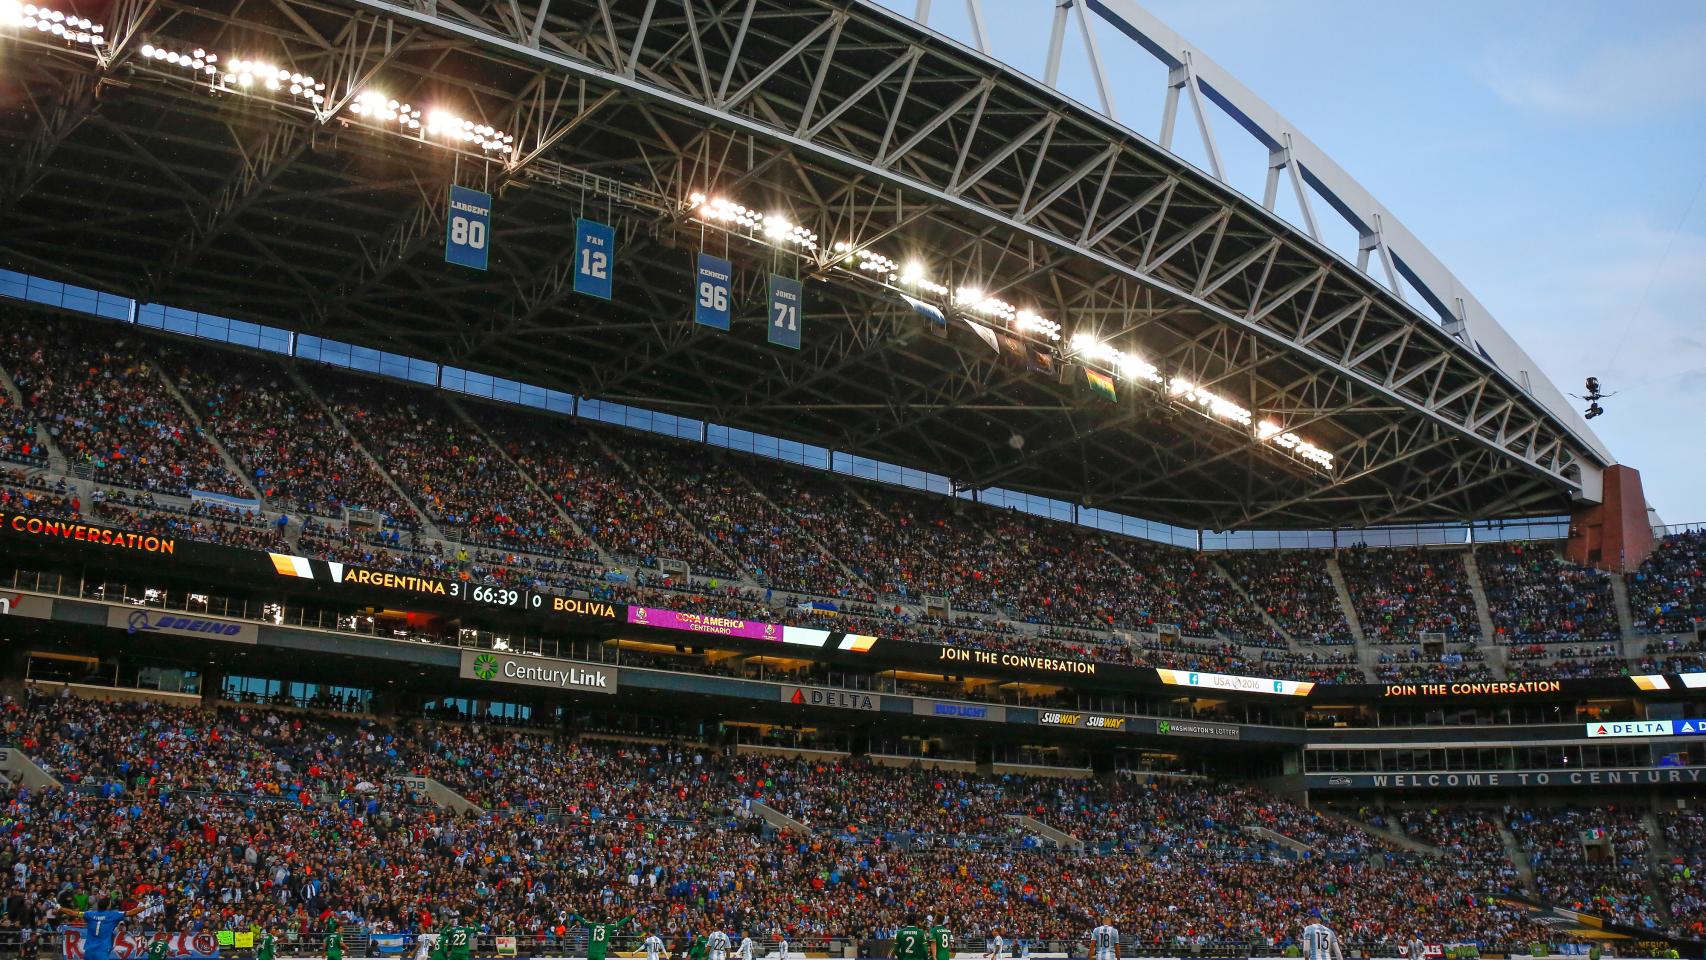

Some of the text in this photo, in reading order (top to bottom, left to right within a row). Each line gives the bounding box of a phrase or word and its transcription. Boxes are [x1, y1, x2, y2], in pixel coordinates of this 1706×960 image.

[451, 200, 489, 217] LARGENT
[451, 216, 486, 250] 80
[580, 248, 607, 280] 12
[700, 268, 729, 281] KENNEDY
[699, 281, 728, 312] 96
[775, 289, 796, 301] JONES
[774, 301, 797, 332] 71
[11, 515, 175, 555] CONVERSATION
[345, 569, 616, 618] ARGENTINA 3 66:39 0 BOLIVIA
[155, 617, 241, 636] BOEING
[675, 613, 745, 629] COPA AMERICA
[690, 623, 731, 635] CENTENARIO
[940, 648, 1095, 674] JOIN THE CONVERSATION
[504, 660, 606, 689] CenturyLink
[1213, 676, 1260, 689] USA 2016
[1385, 681, 1560, 697] JOIN THE CONVERSATION
[811, 690, 873, 709] DELTA
[934, 703, 988, 718] BUD LIGHT
[1041, 712, 1081, 726] SUBWAY
[1086, 715, 1125, 729] SUBWAY
[1170, 725, 1239, 736] WASHINGTON'S LOTTERY
[1613, 723, 1665, 733] DELTA
[1373, 769, 1700, 787] WELCOME TO CENTURY
[95, 921, 101, 936] 1
[593, 927, 606, 941] 13
[330, 937, 335, 948] 3
[453, 933, 467, 946] 22
[714, 938, 726, 951] 22
[905, 936, 915, 954] 2
[941, 933, 949, 948] 8
[1100, 932, 1110, 948] 18
[1315, 931, 1329, 950] 13
[154, 943, 161, 953] 5
